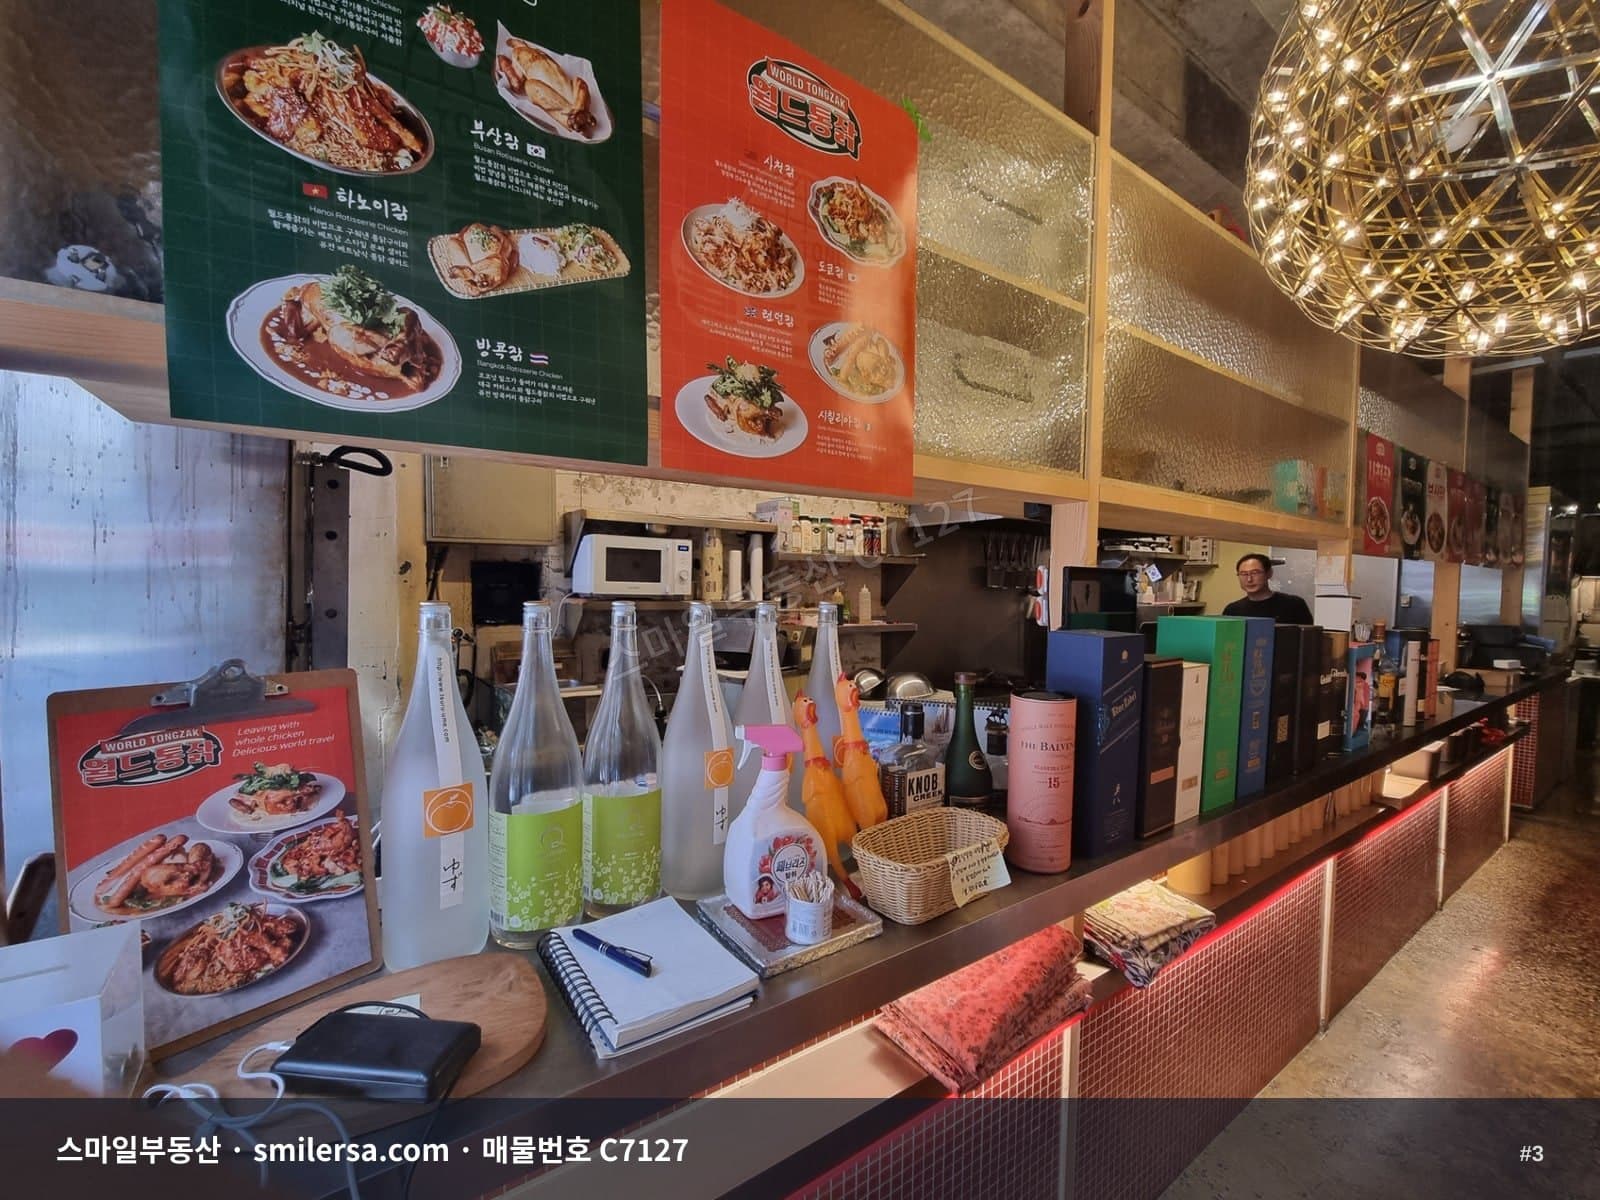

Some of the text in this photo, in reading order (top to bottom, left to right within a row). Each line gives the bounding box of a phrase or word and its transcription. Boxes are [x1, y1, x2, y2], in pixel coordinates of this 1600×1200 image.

[770, 64, 846, 110] WORLD TONGZAK
[377, 222, 408, 236] Chicken
[235, 730, 304, 746] whole chicken
[238, 720, 301, 737] Leaving with
[105, 729, 201, 753] WORLD TONGZAK
[232, 734, 335, 758] Delicious world travel
[908, 773, 938, 797] KNOB
[1048, 777, 1060, 789] 15
[913, 788, 943, 802] CREEK
[441, 858, 463, 891] ゆず
